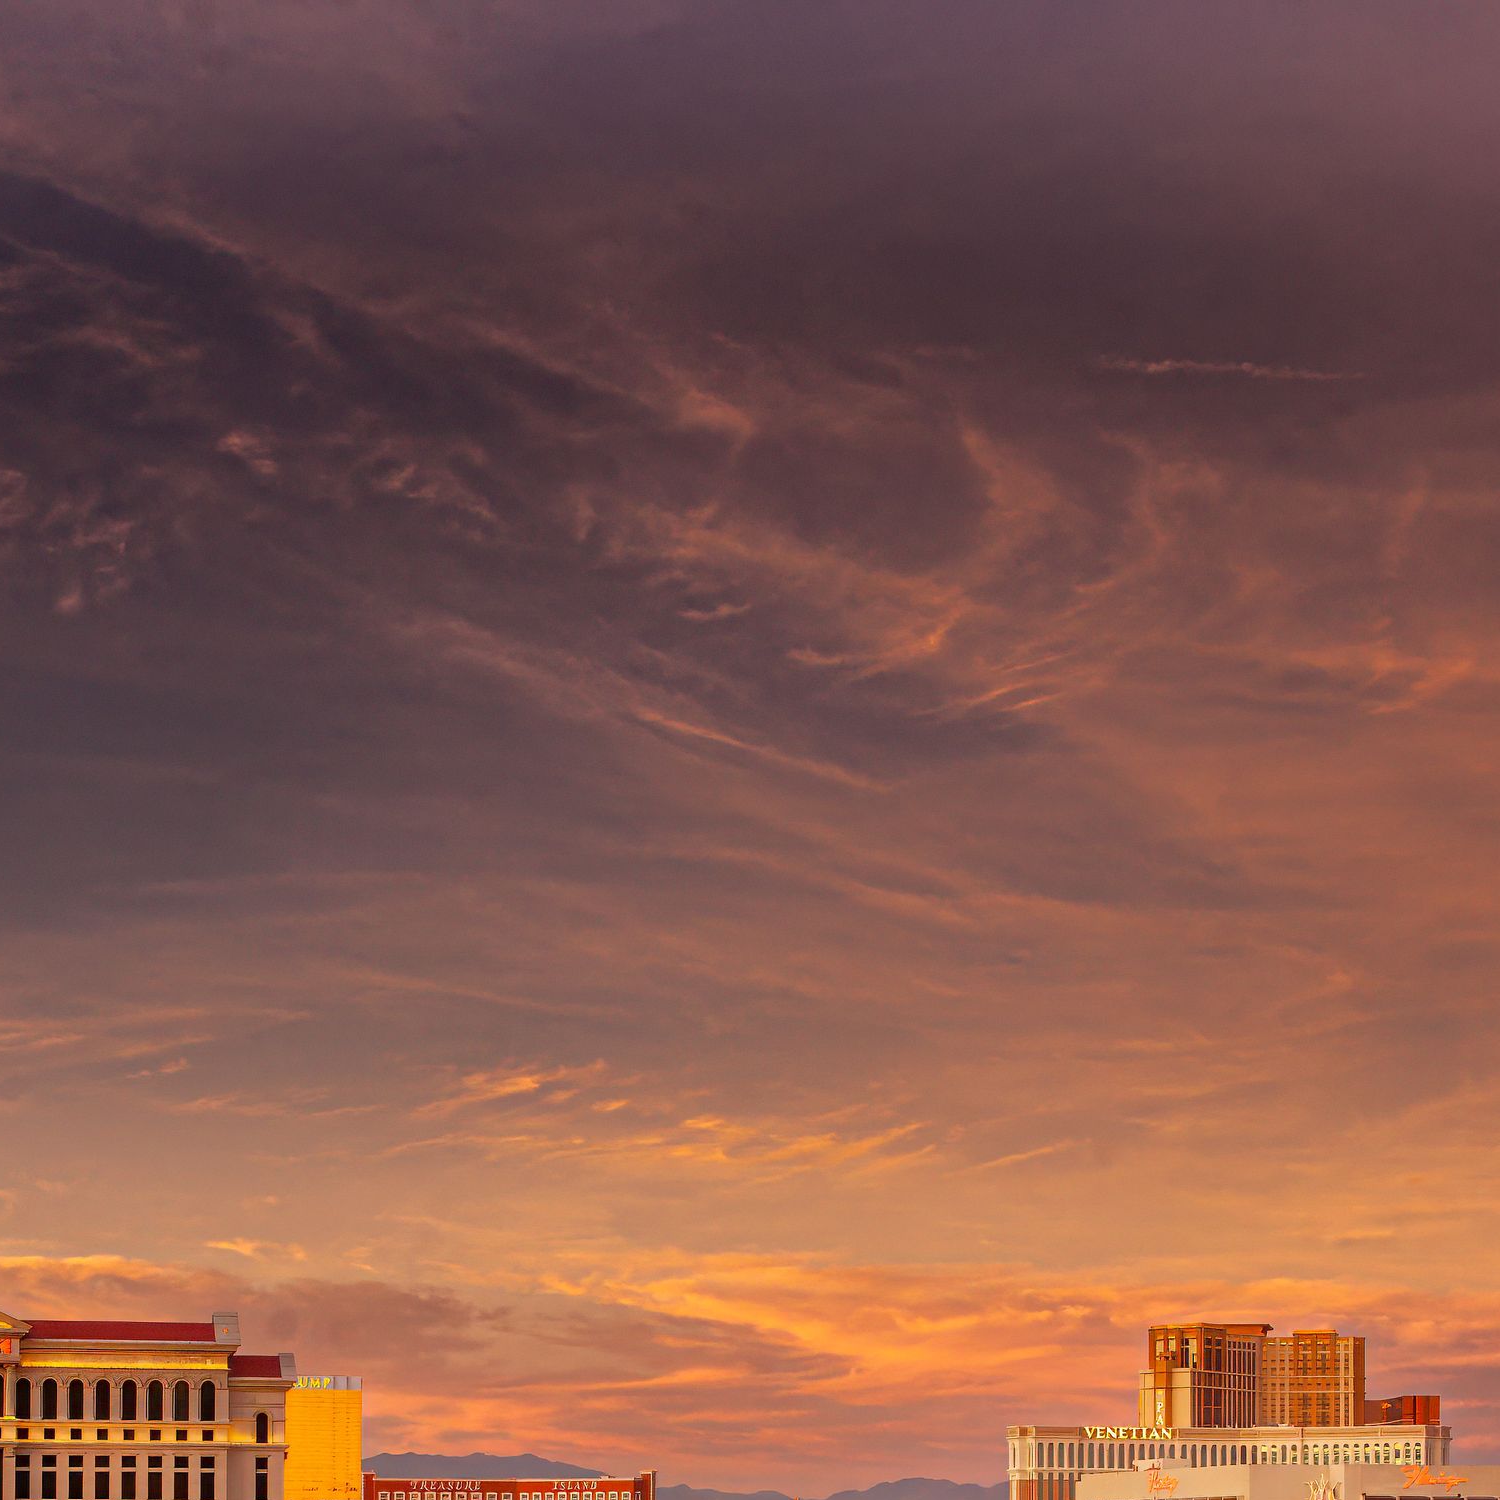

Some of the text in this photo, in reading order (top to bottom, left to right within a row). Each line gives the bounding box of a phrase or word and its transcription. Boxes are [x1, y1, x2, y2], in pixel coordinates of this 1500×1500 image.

[293, 1376, 331, 1388] UMP
[1084, 1426, 1173, 1440] VENETIAN
[410, 1480, 598, 1491] TREASURE ISLAND
